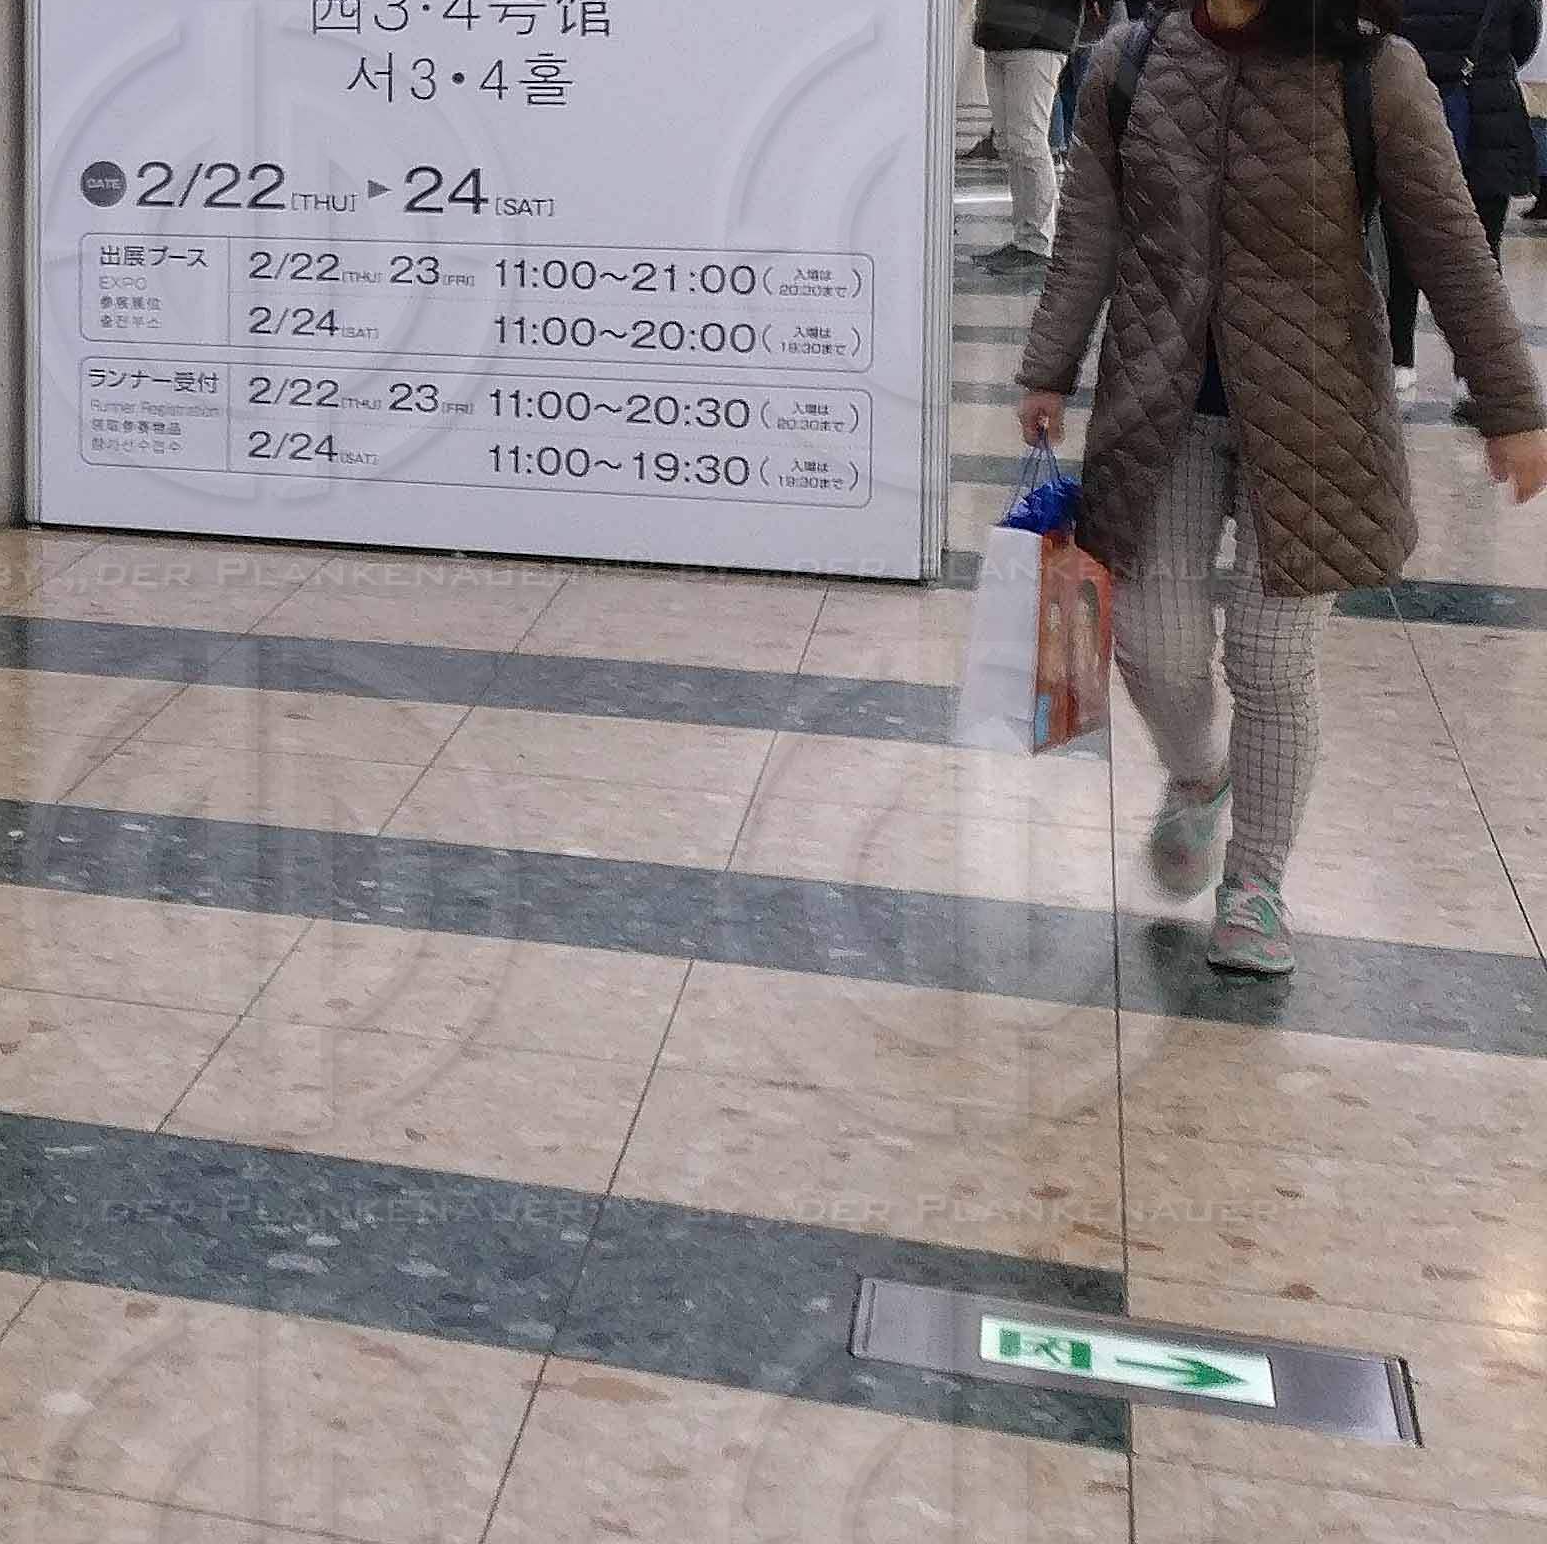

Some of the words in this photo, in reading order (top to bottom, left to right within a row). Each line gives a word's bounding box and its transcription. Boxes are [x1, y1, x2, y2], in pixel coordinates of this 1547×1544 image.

[100, 245, 209, 267] 出展ブース
[88, 369, 219, 393] ランナー受付
